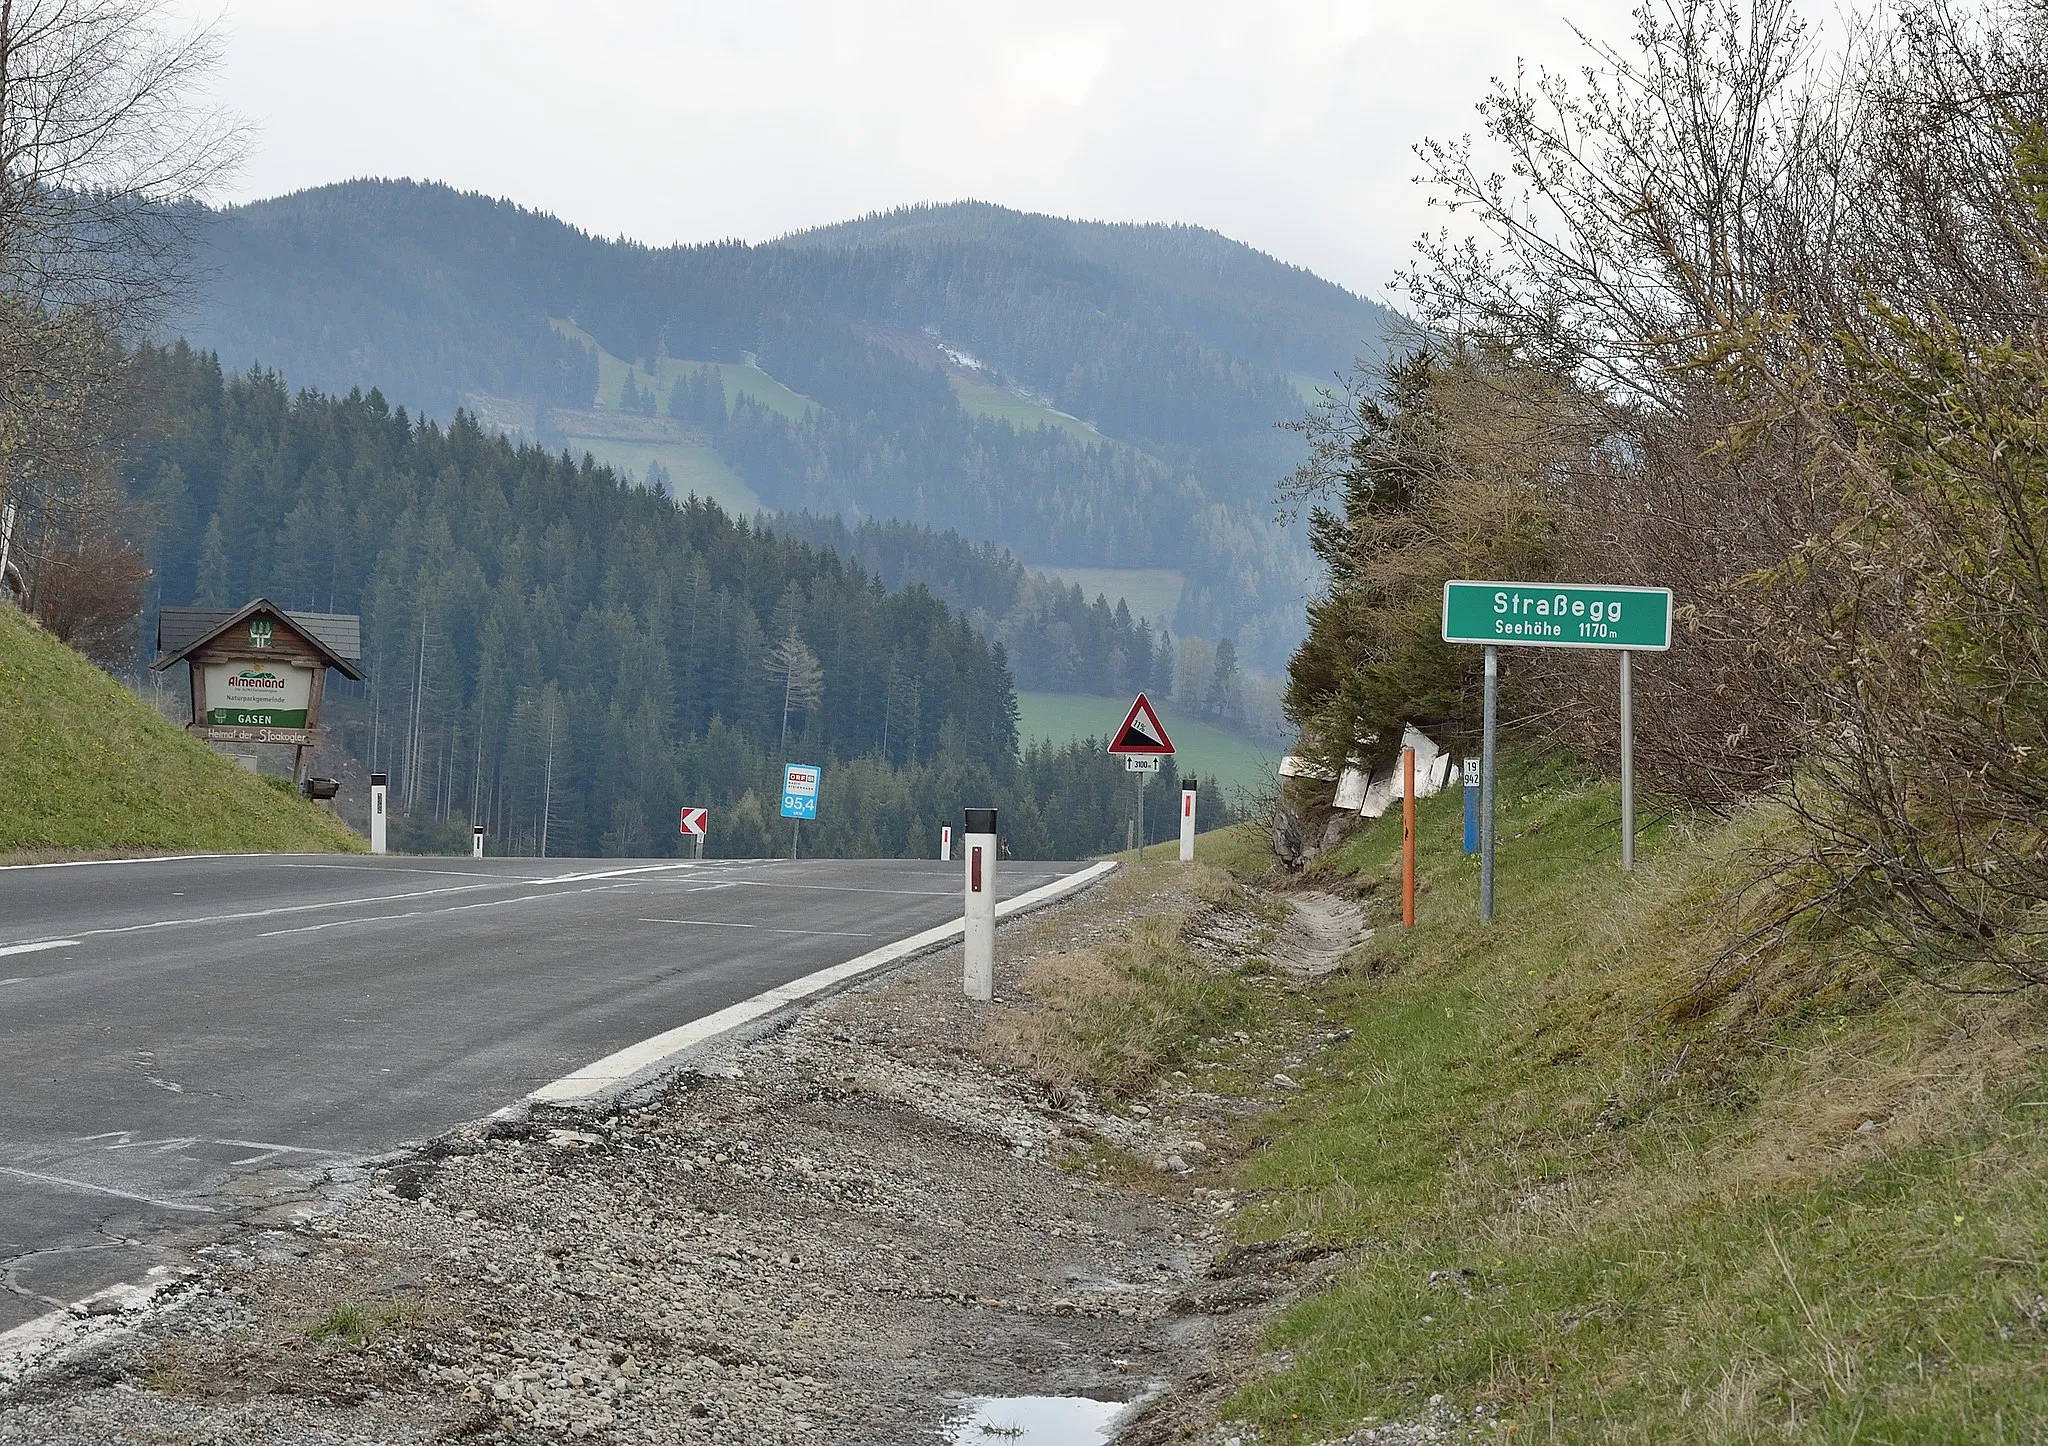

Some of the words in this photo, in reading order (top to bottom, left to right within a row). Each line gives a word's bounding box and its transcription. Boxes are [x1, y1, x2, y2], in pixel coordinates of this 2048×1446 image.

[1494, 592, 1622, 622] Straßegg
[1495, 620, 1561, 636] Seehöhe
[228, 677, 285, 689] Almenland
[226, 694, 285, 704] Naturparkgemeinde
[238, 714, 272, 724] GASEN
[1133, 720, 1147, 732] 11%
[208, 728, 236, 740] Heimat
[239, 728, 253, 740] der
[258, 728, 307, 744] Stoakogler
[1467, 761, 1477, 772] 19
[1464, 774, 1479, 784] 942
[784, 796, 815, 812] 95,4
